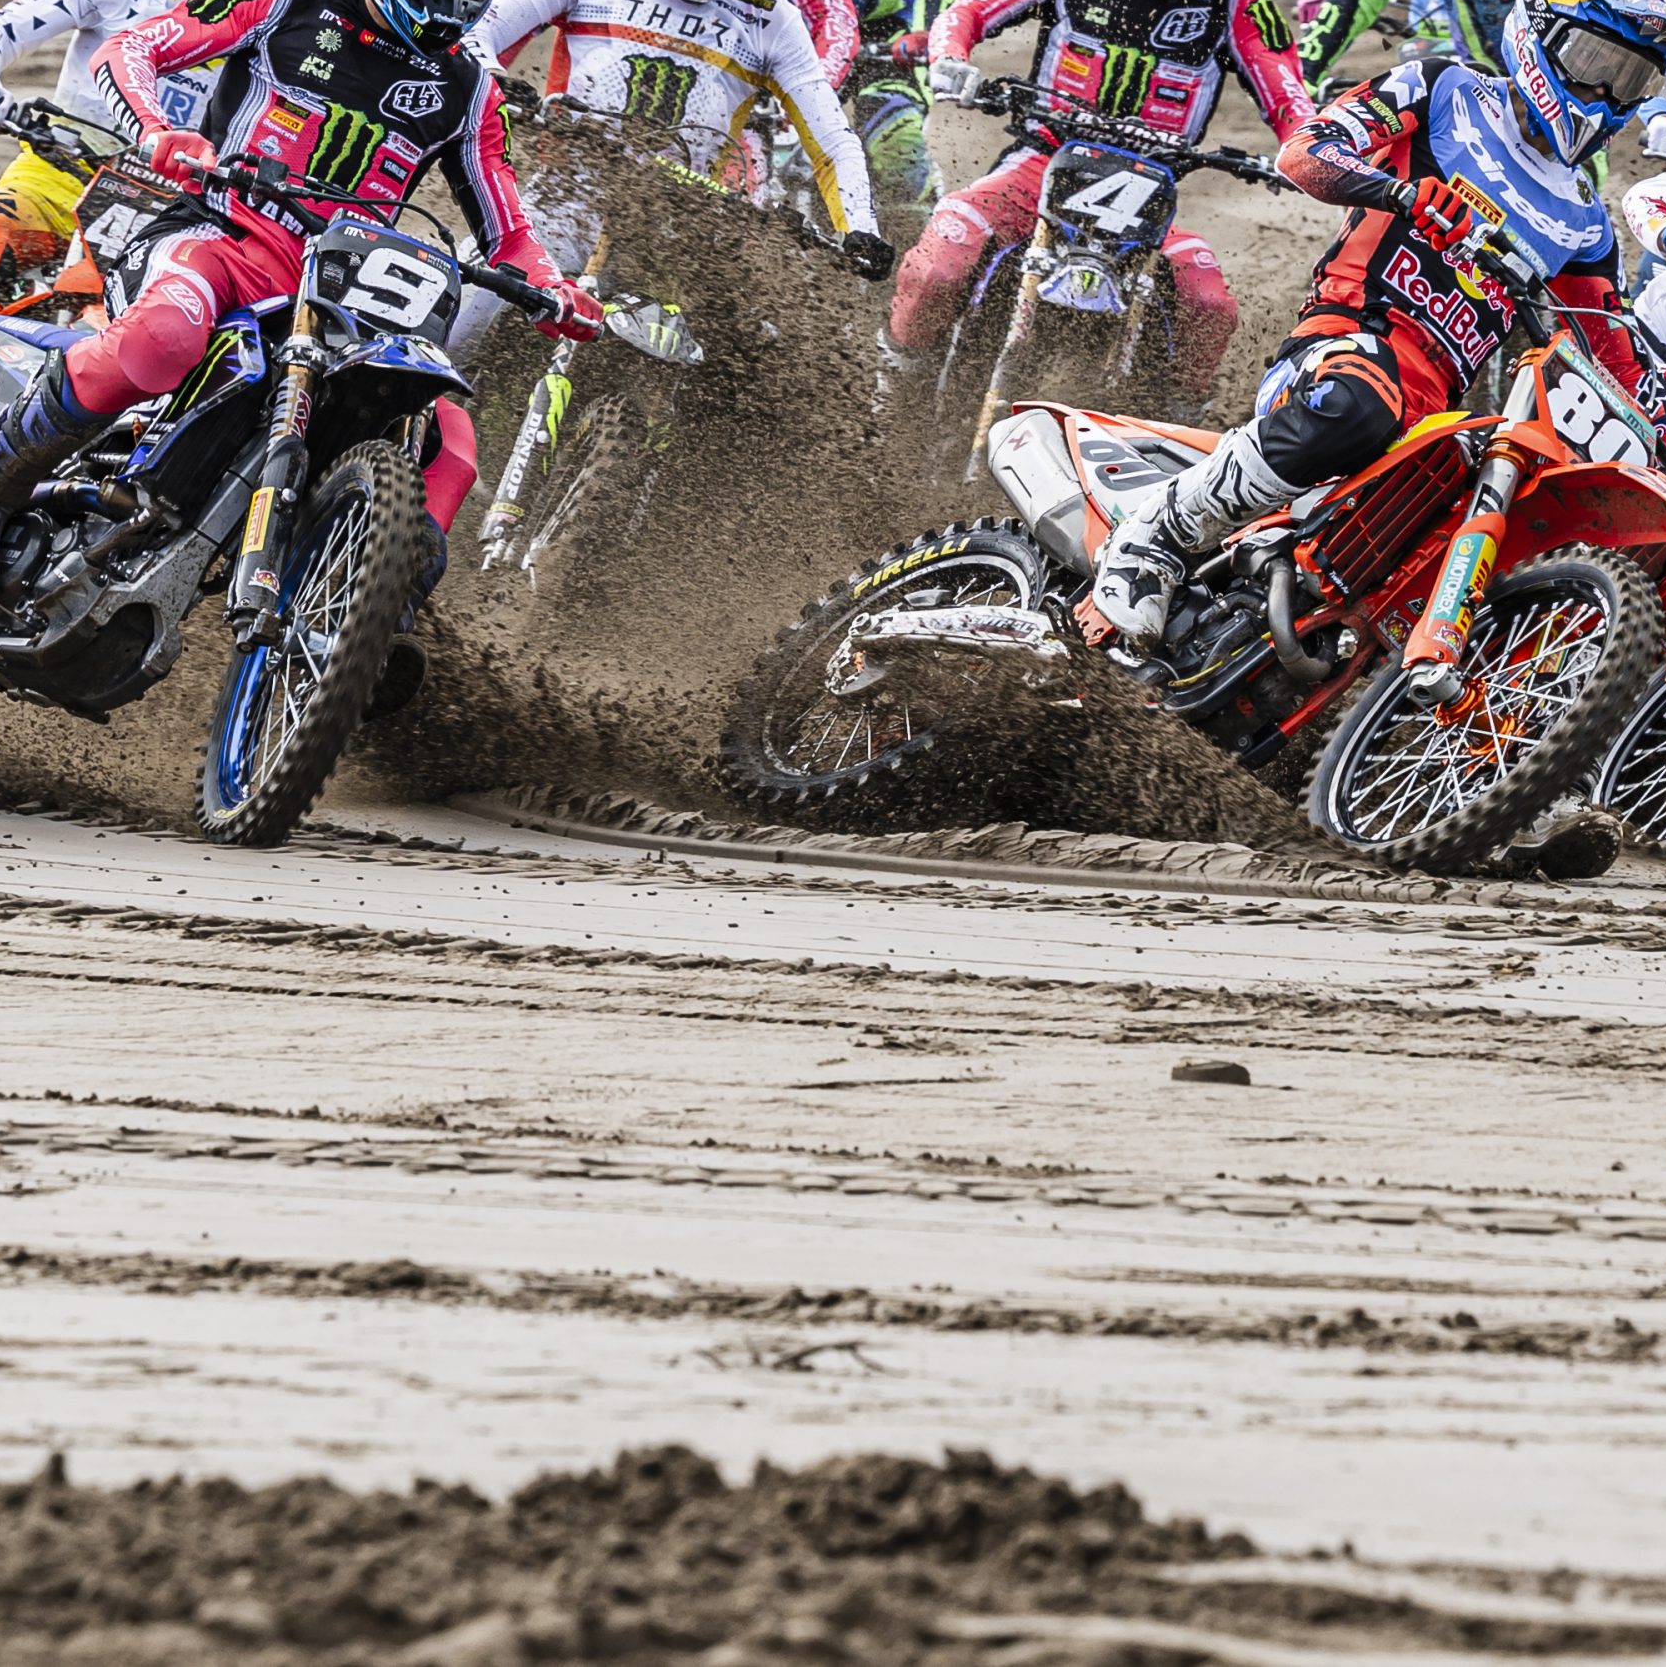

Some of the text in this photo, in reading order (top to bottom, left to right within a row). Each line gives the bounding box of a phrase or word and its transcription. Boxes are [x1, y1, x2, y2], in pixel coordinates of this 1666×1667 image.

[1528, 72, 1563, 124] Bull
[1062, 169, 1161, 234] 4
[1451, 176, 1503, 225] PIRELLI
[340, 246, 449, 329] 9
[1382, 244, 1501, 372] Red Bull
[1546, 372, 1649, 468] 80
[1571, 358, 1627, 418] MOTOREX
[506, 413, 543, 501] DUNLOP
[852, 536, 972, 599] PIRELLI
[1433, 554, 1470, 617] MOTOREX
